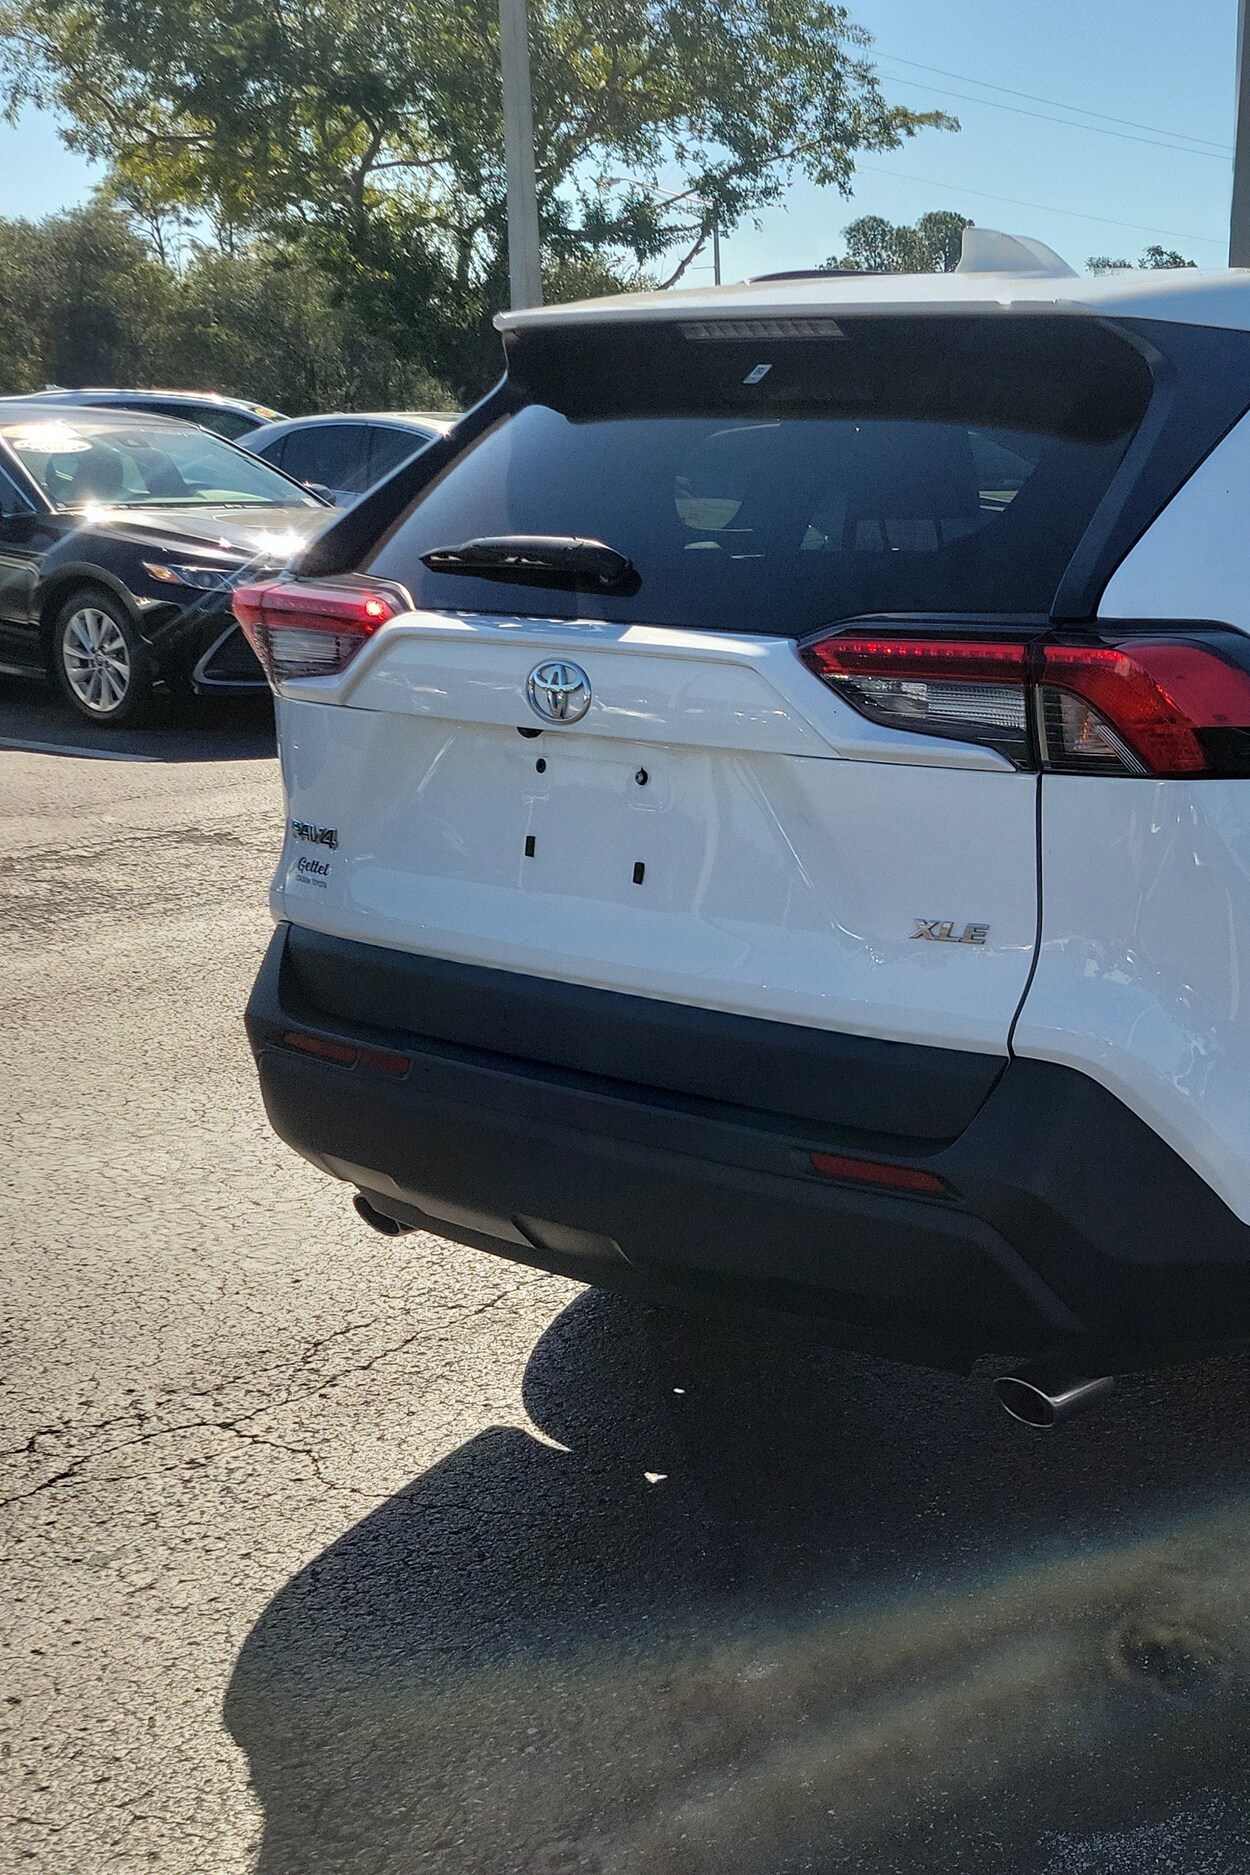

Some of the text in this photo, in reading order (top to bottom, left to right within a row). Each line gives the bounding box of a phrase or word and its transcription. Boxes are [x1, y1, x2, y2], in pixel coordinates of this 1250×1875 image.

[291, 818, 339, 850] RAV4
[297, 856, 331, 876] Gettel
[908, 918, 991, 945] XLE
